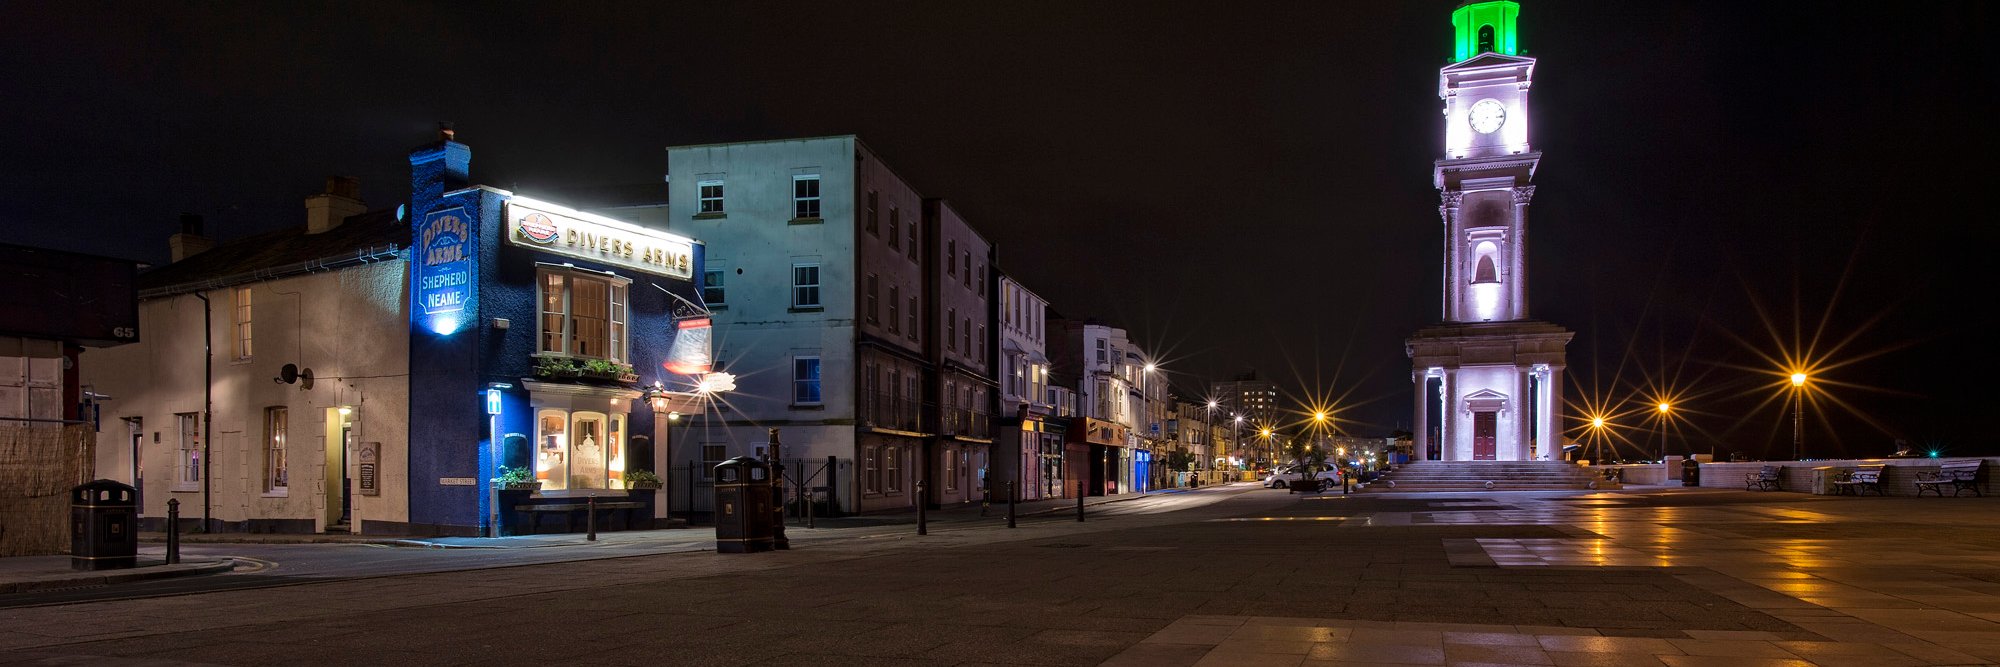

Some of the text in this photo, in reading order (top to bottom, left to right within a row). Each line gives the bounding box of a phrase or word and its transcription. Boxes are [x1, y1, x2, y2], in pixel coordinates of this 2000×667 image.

[423, 215, 468, 254] DIVERS
[426, 244, 463, 266] ARMS
[567, 228, 633, 257] DIVERS
[643, 246, 688, 270] ARMS
[422, 271, 467, 290] SHEPHERD
[428, 291, 461, 308] NEAME
[113, 326, 135, 338] 65
